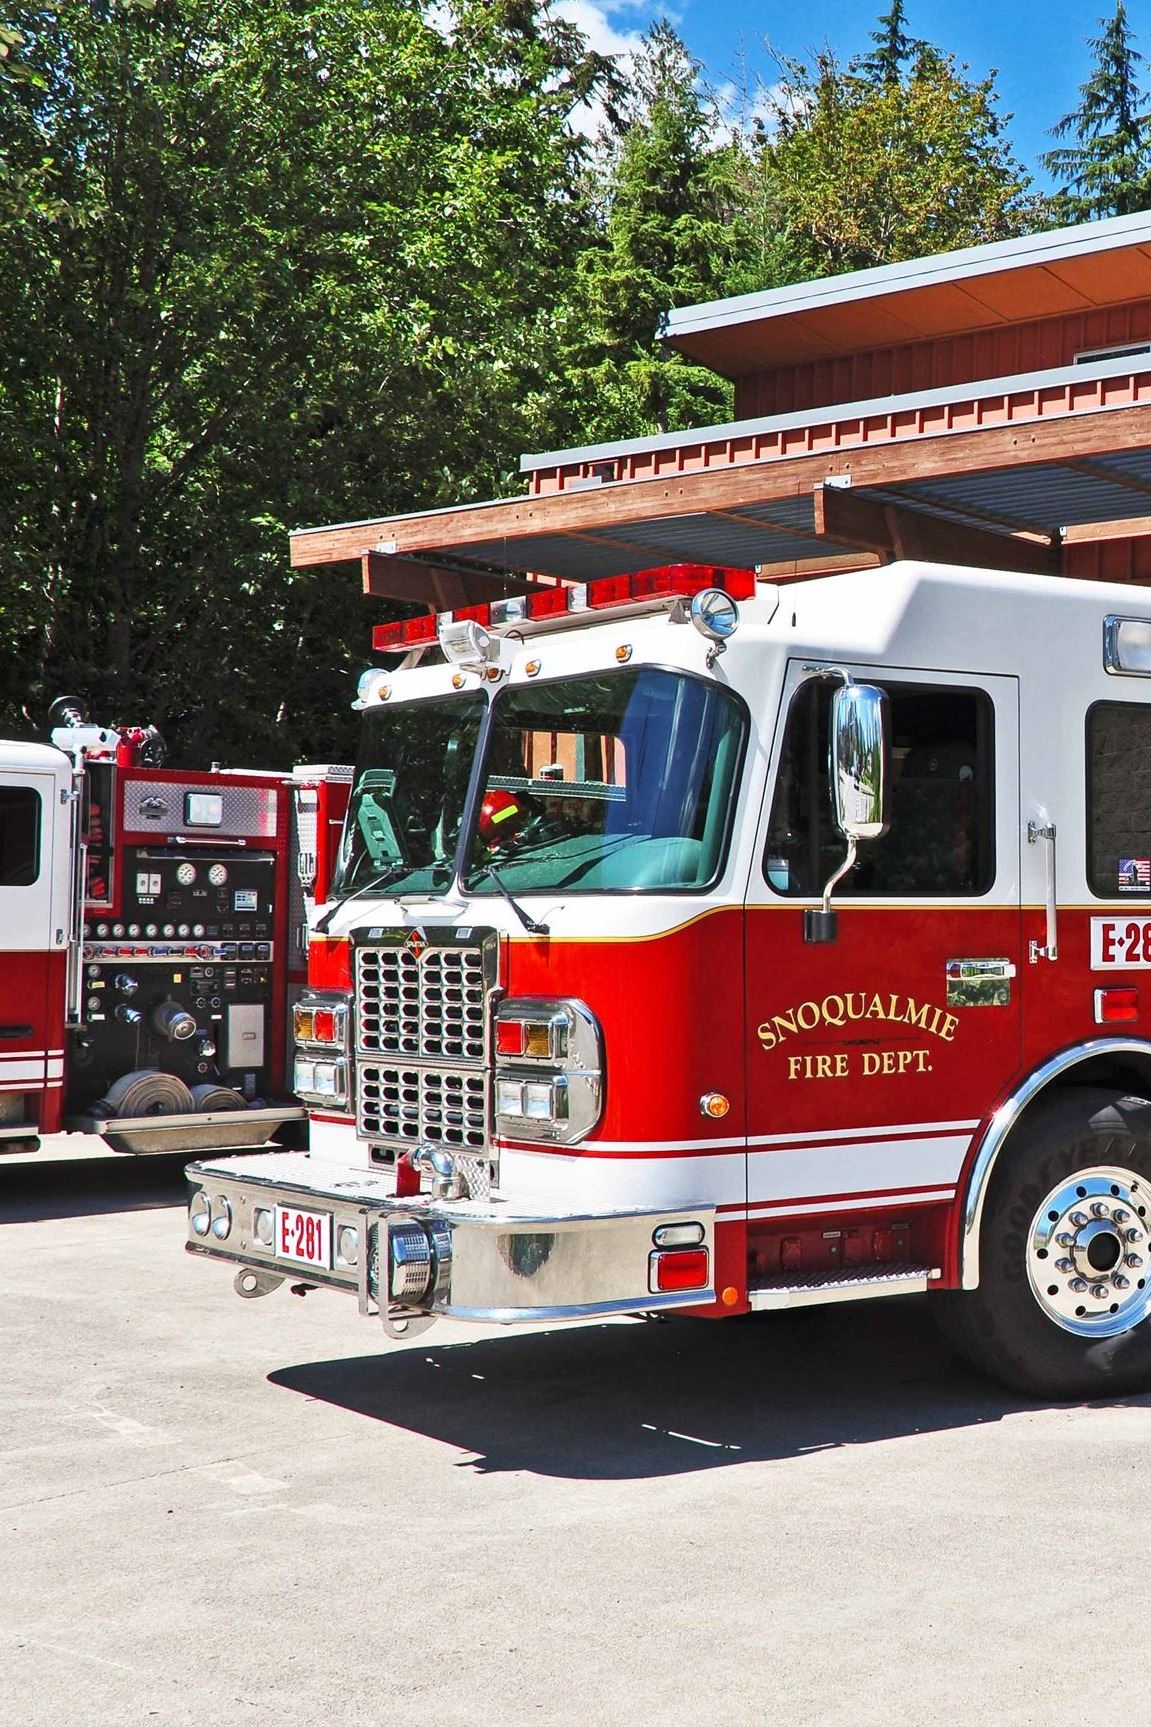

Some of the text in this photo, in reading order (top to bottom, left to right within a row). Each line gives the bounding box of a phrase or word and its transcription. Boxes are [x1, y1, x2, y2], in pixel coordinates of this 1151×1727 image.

[757, 992, 960, 1050] SNOQUALMIE
[788, 1049, 933, 1080] FIRE DEPT.
